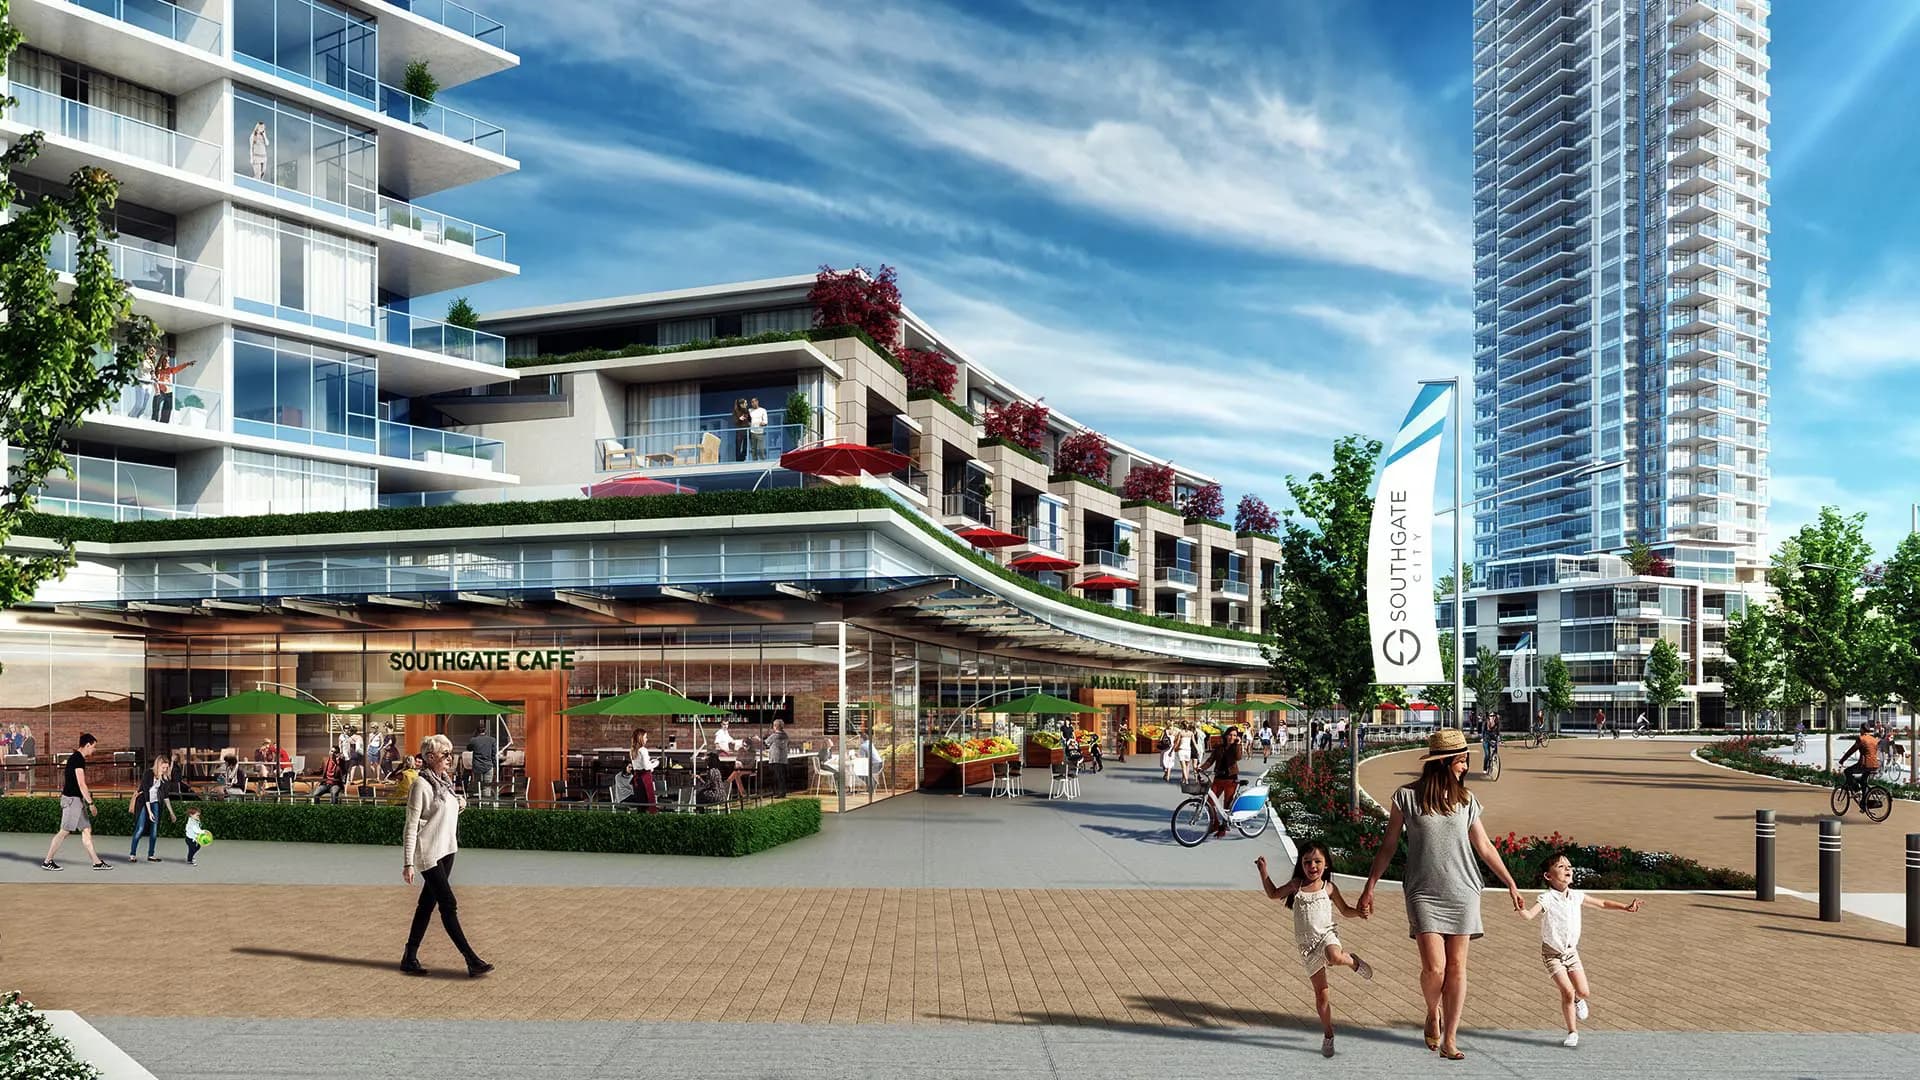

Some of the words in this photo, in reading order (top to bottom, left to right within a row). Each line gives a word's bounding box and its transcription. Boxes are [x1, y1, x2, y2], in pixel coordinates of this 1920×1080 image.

[1390, 490, 1407, 622] SOUTHGATE
[1413, 533, 1422, 582] CITY
[389, 650, 510, 671] SOUTHGATE
[516, 650, 576, 671] CAFE
[1091, 675, 1137, 690] MARKET
